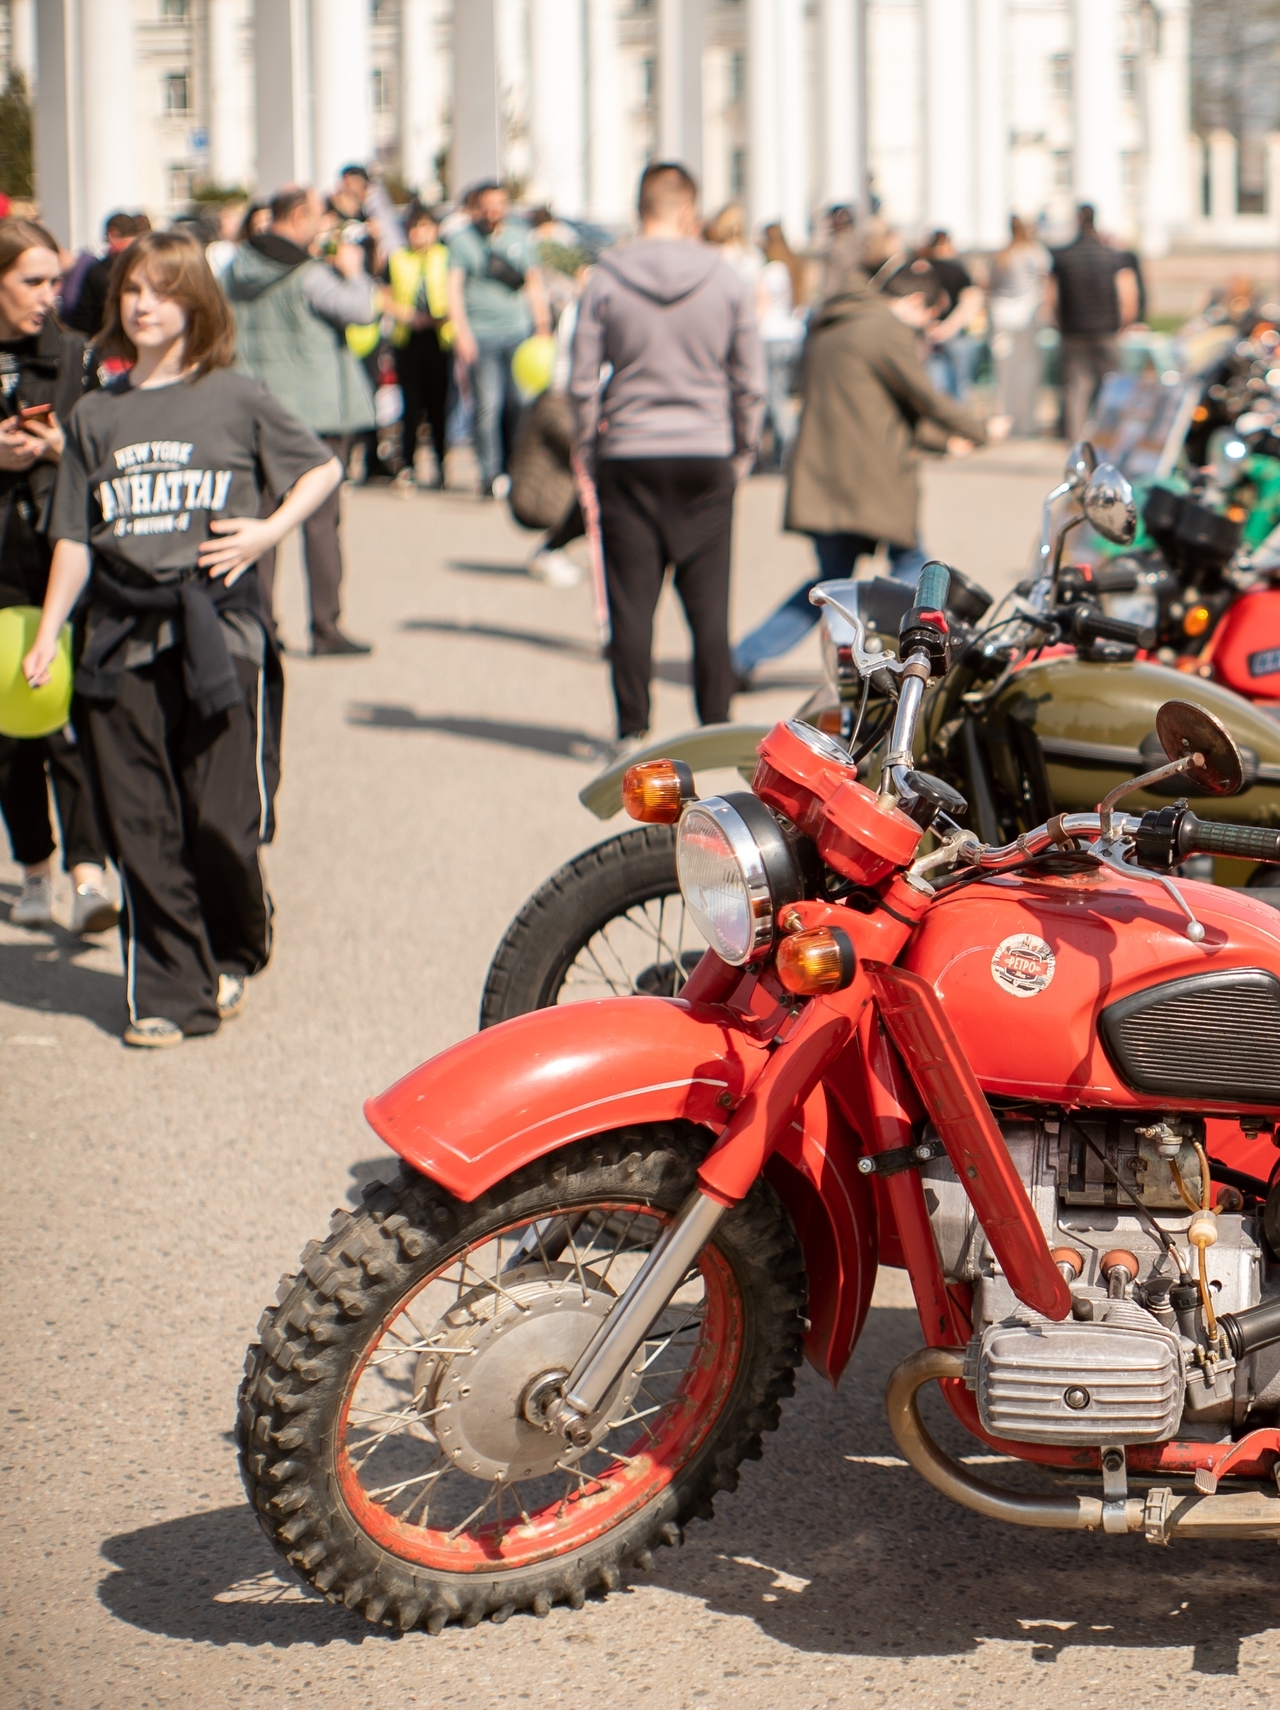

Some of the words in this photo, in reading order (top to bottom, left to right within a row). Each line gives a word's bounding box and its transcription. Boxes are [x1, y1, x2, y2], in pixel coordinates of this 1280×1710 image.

[114, 441, 150, 470] NEW
[150, 440, 194, 465] YORK
[1008, 956, 1036, 973] РЕТРО
